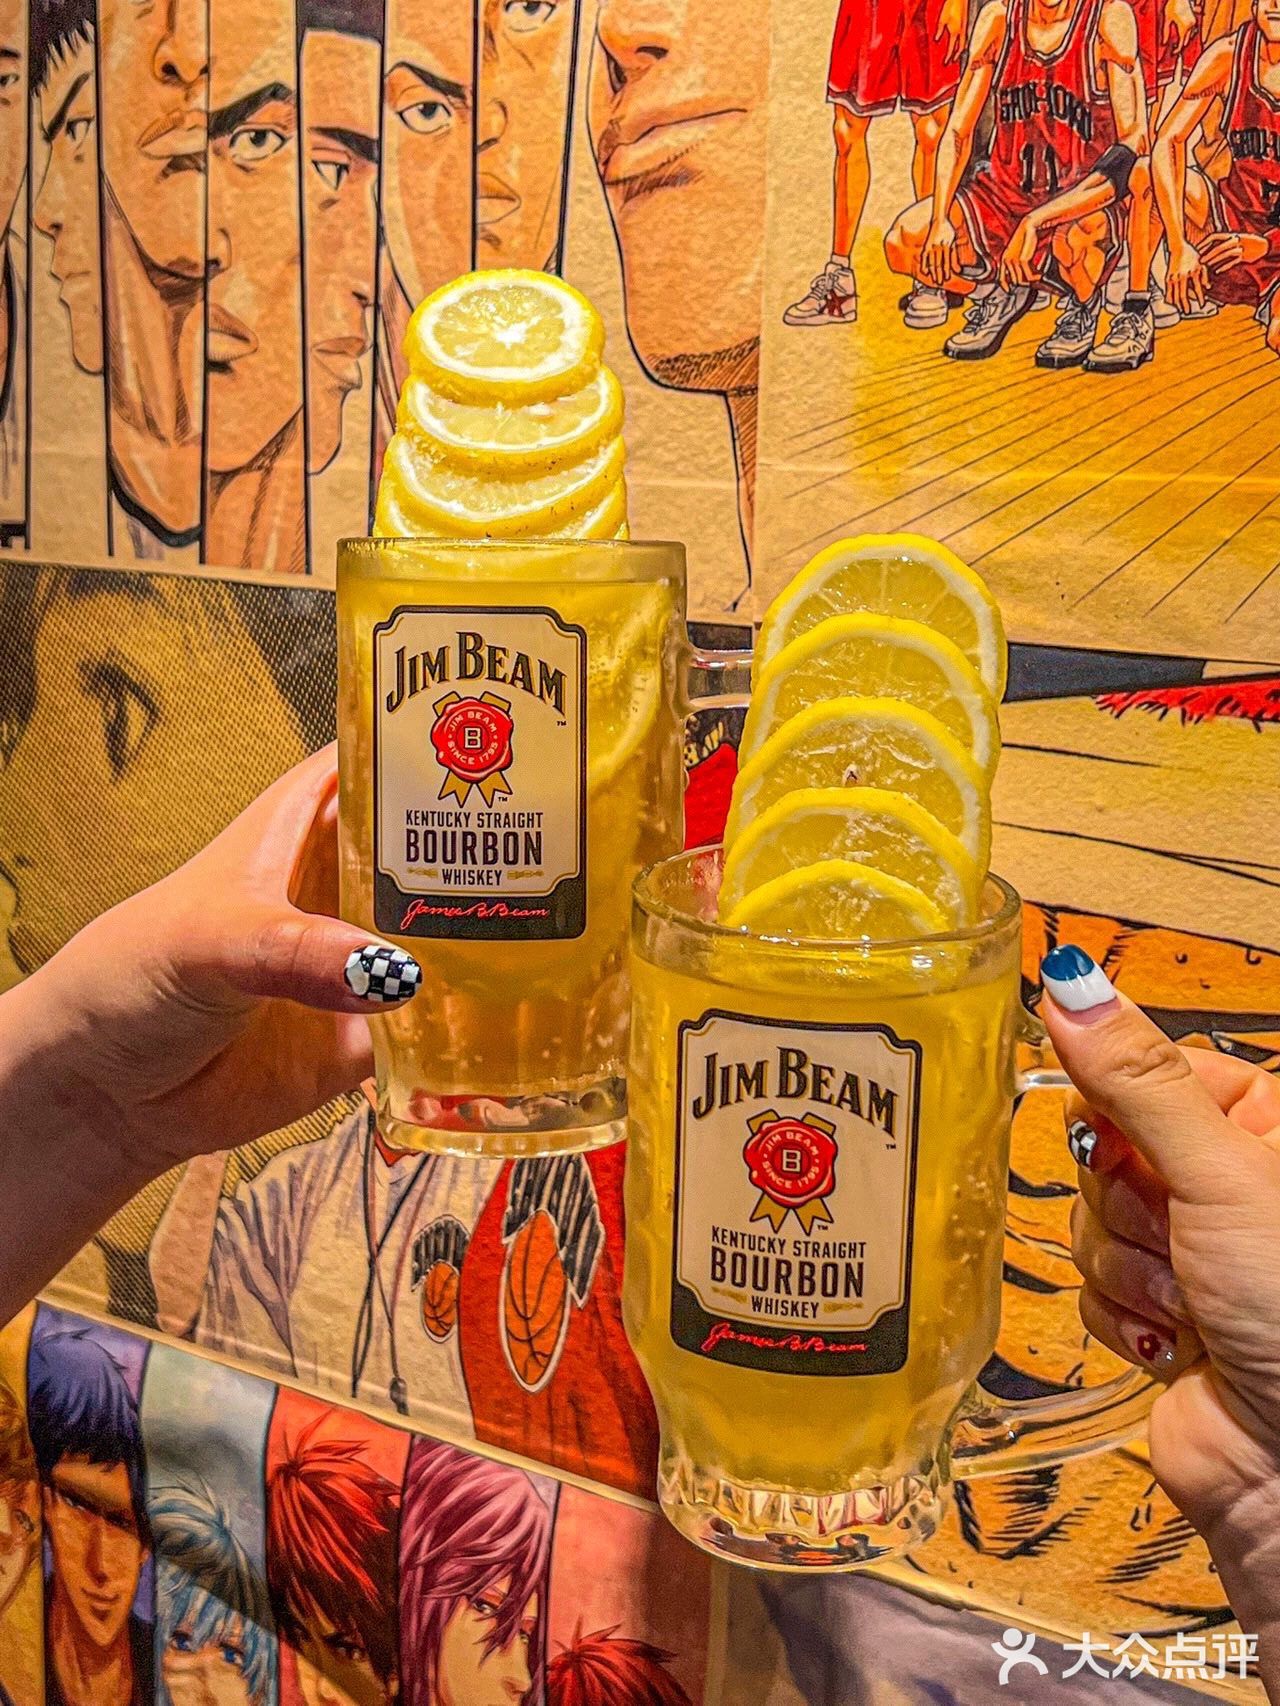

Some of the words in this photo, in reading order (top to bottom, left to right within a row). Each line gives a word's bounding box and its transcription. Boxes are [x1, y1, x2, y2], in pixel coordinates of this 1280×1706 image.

[386, 645, 450, 713] JIM
[456, 631, 567, 716] BEAM
[449, 714, 464, 732] JIM
[467, 711, 498, 733] BEAM
[464, 727, 481, 749] B
[447, 741, 475, 765] SINCE
[406, 809, 472, 828] KENTUCKY
[477, 812, 544, 829] STRAIGHT
[405, 829, 543, 866] BOURBON
[442, 869, 503, 886] WHISKEY
[692, 1052, 770, 1119] JIM
[776, 1046, 898, 1139] BEAM
[765, 1134, 782, 1152] JIM
[785, 1131, 819, 1156] BEAM
[782, 1149, 801, 1172] B
[762, 1161, 793, 1189] SINCE
[711, 1225, 786, 1255] KENTUCKY
[793, 1240, 867, 1259] STRAIGHT
[710, 1245, 864, 1298] BOURBON
[751, 1295, 820, 1318] WHISKEY
